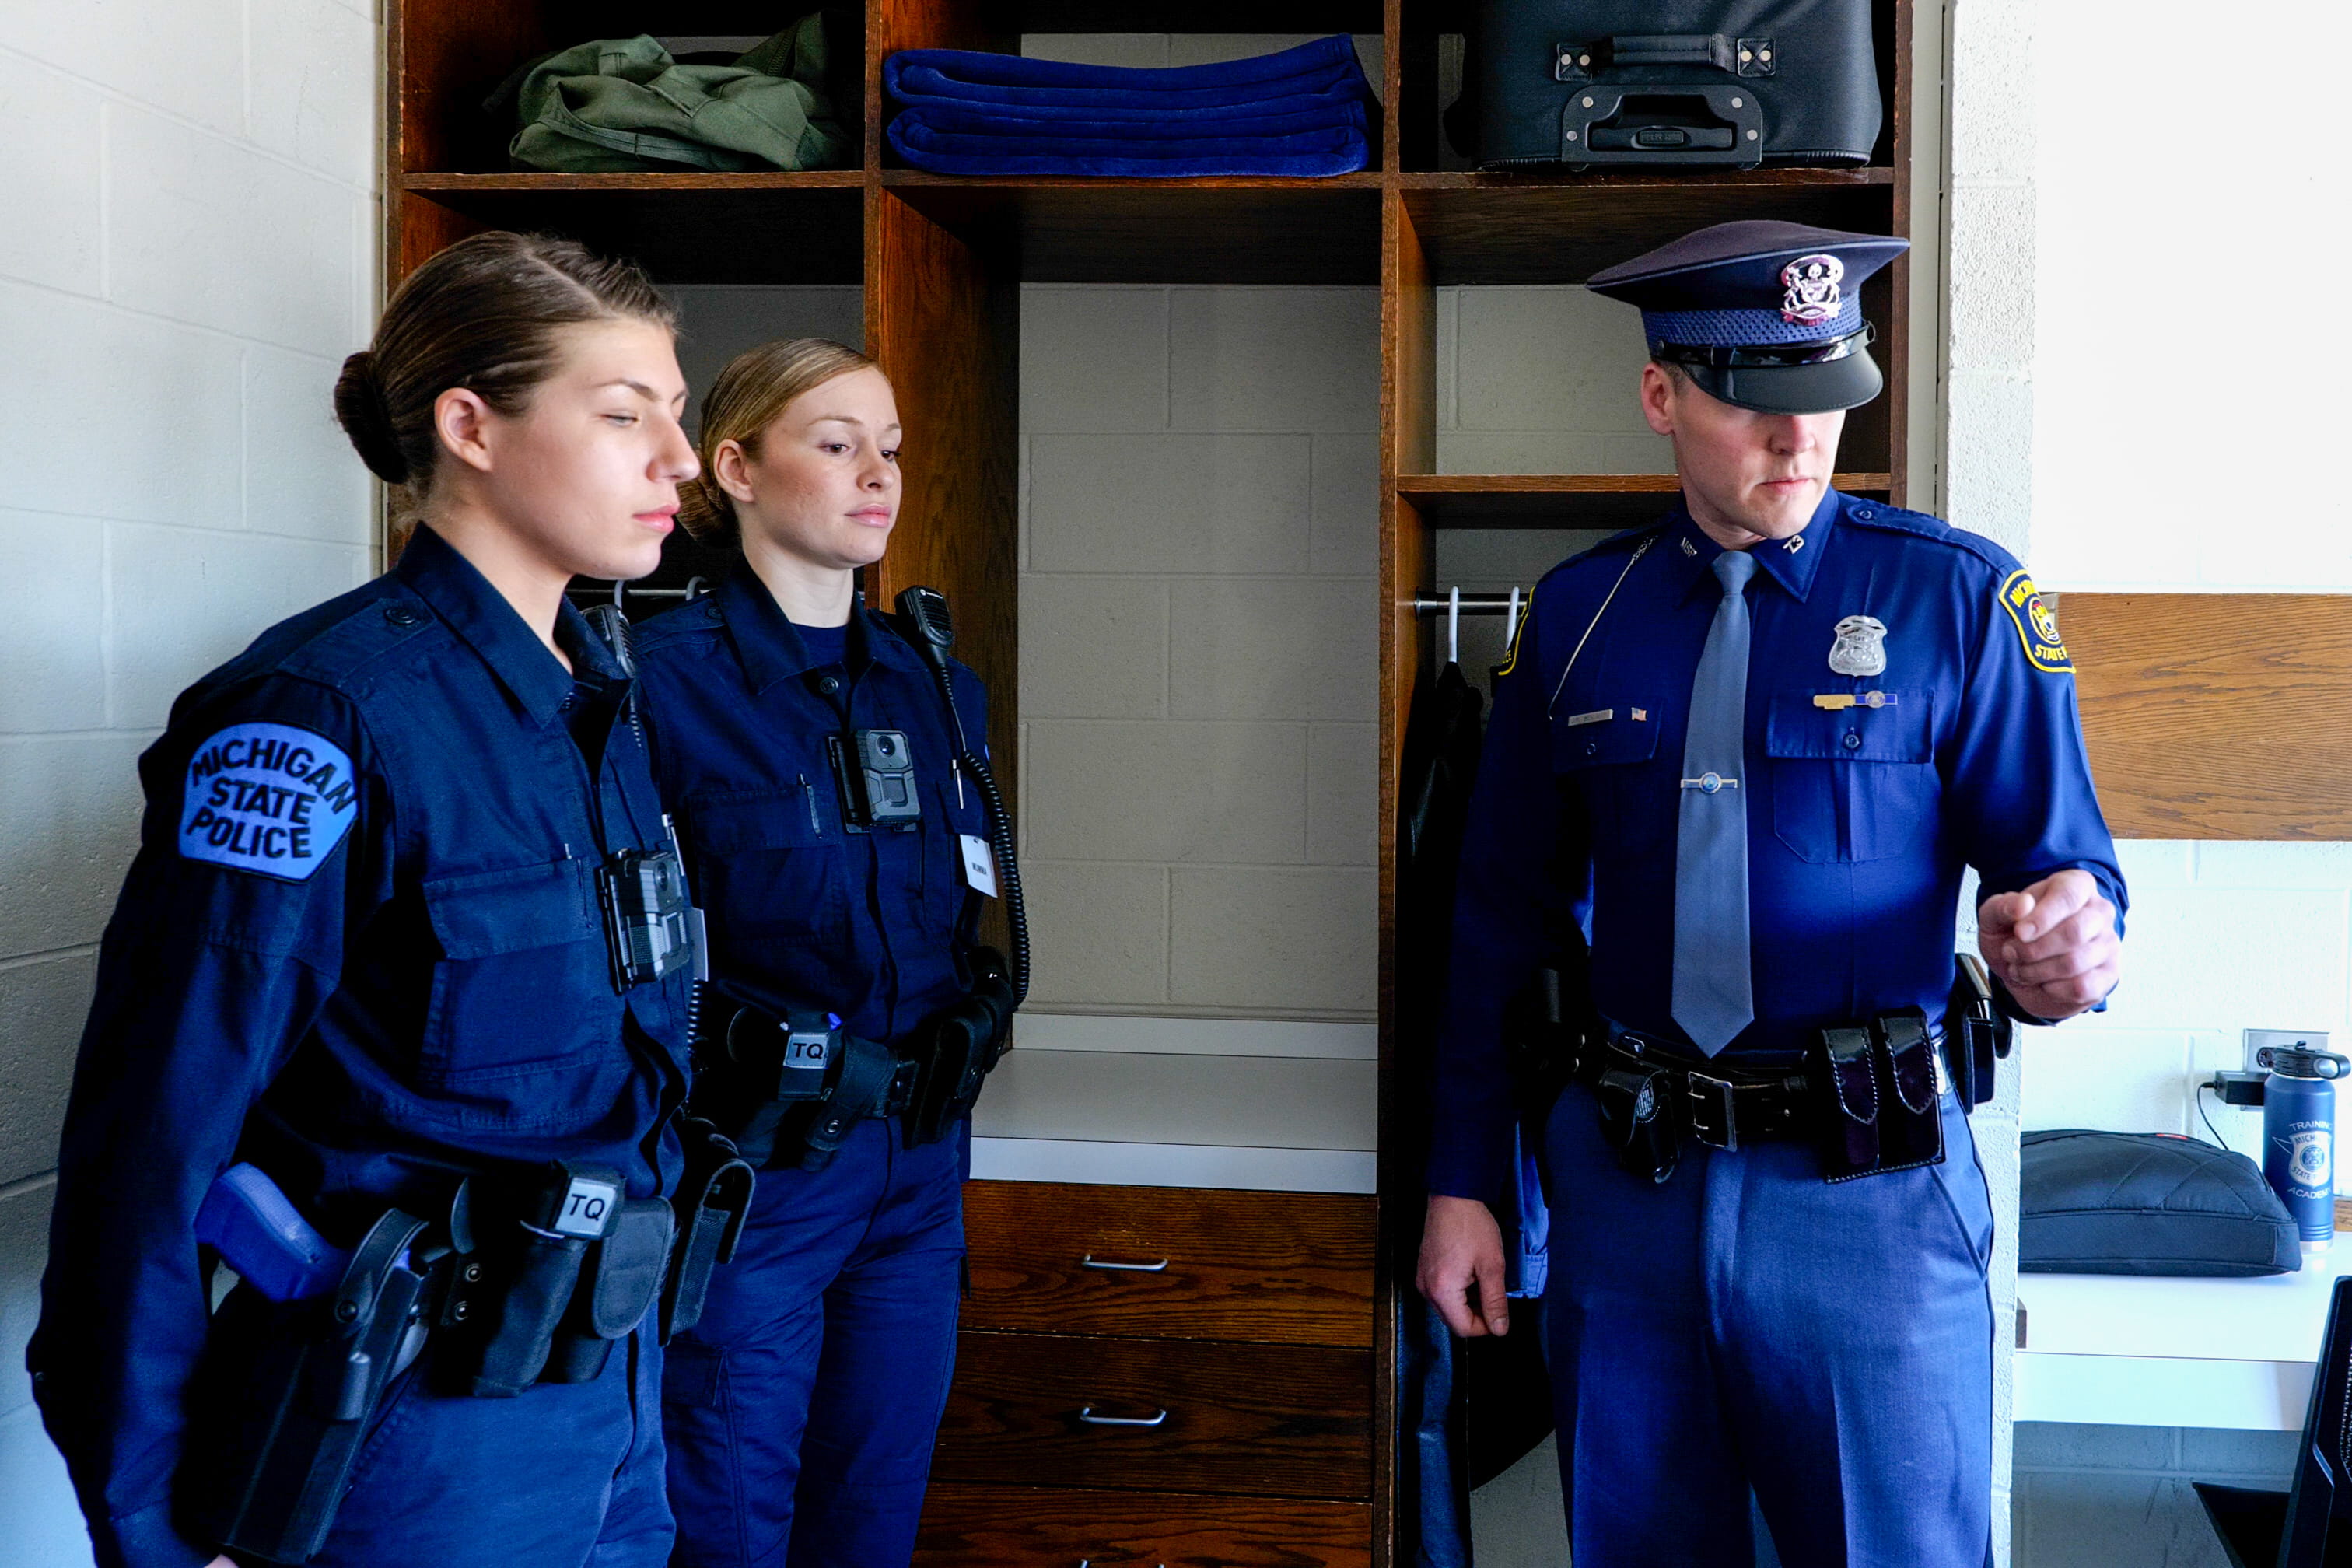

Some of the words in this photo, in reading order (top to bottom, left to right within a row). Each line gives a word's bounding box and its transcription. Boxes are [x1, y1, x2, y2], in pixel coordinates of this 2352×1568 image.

[2035, 644, 2065, 660] STATE
[192, 737, 357, 815] MICHIGAN
[208, 776, 317, 825] STATE
[185, 805, 313, 859] POLICE
[793, 1042, 824, 1060] TQ
[2291, 1167, 2311, 1181] STATE
[569, 1193, 605, 1221] TQ
